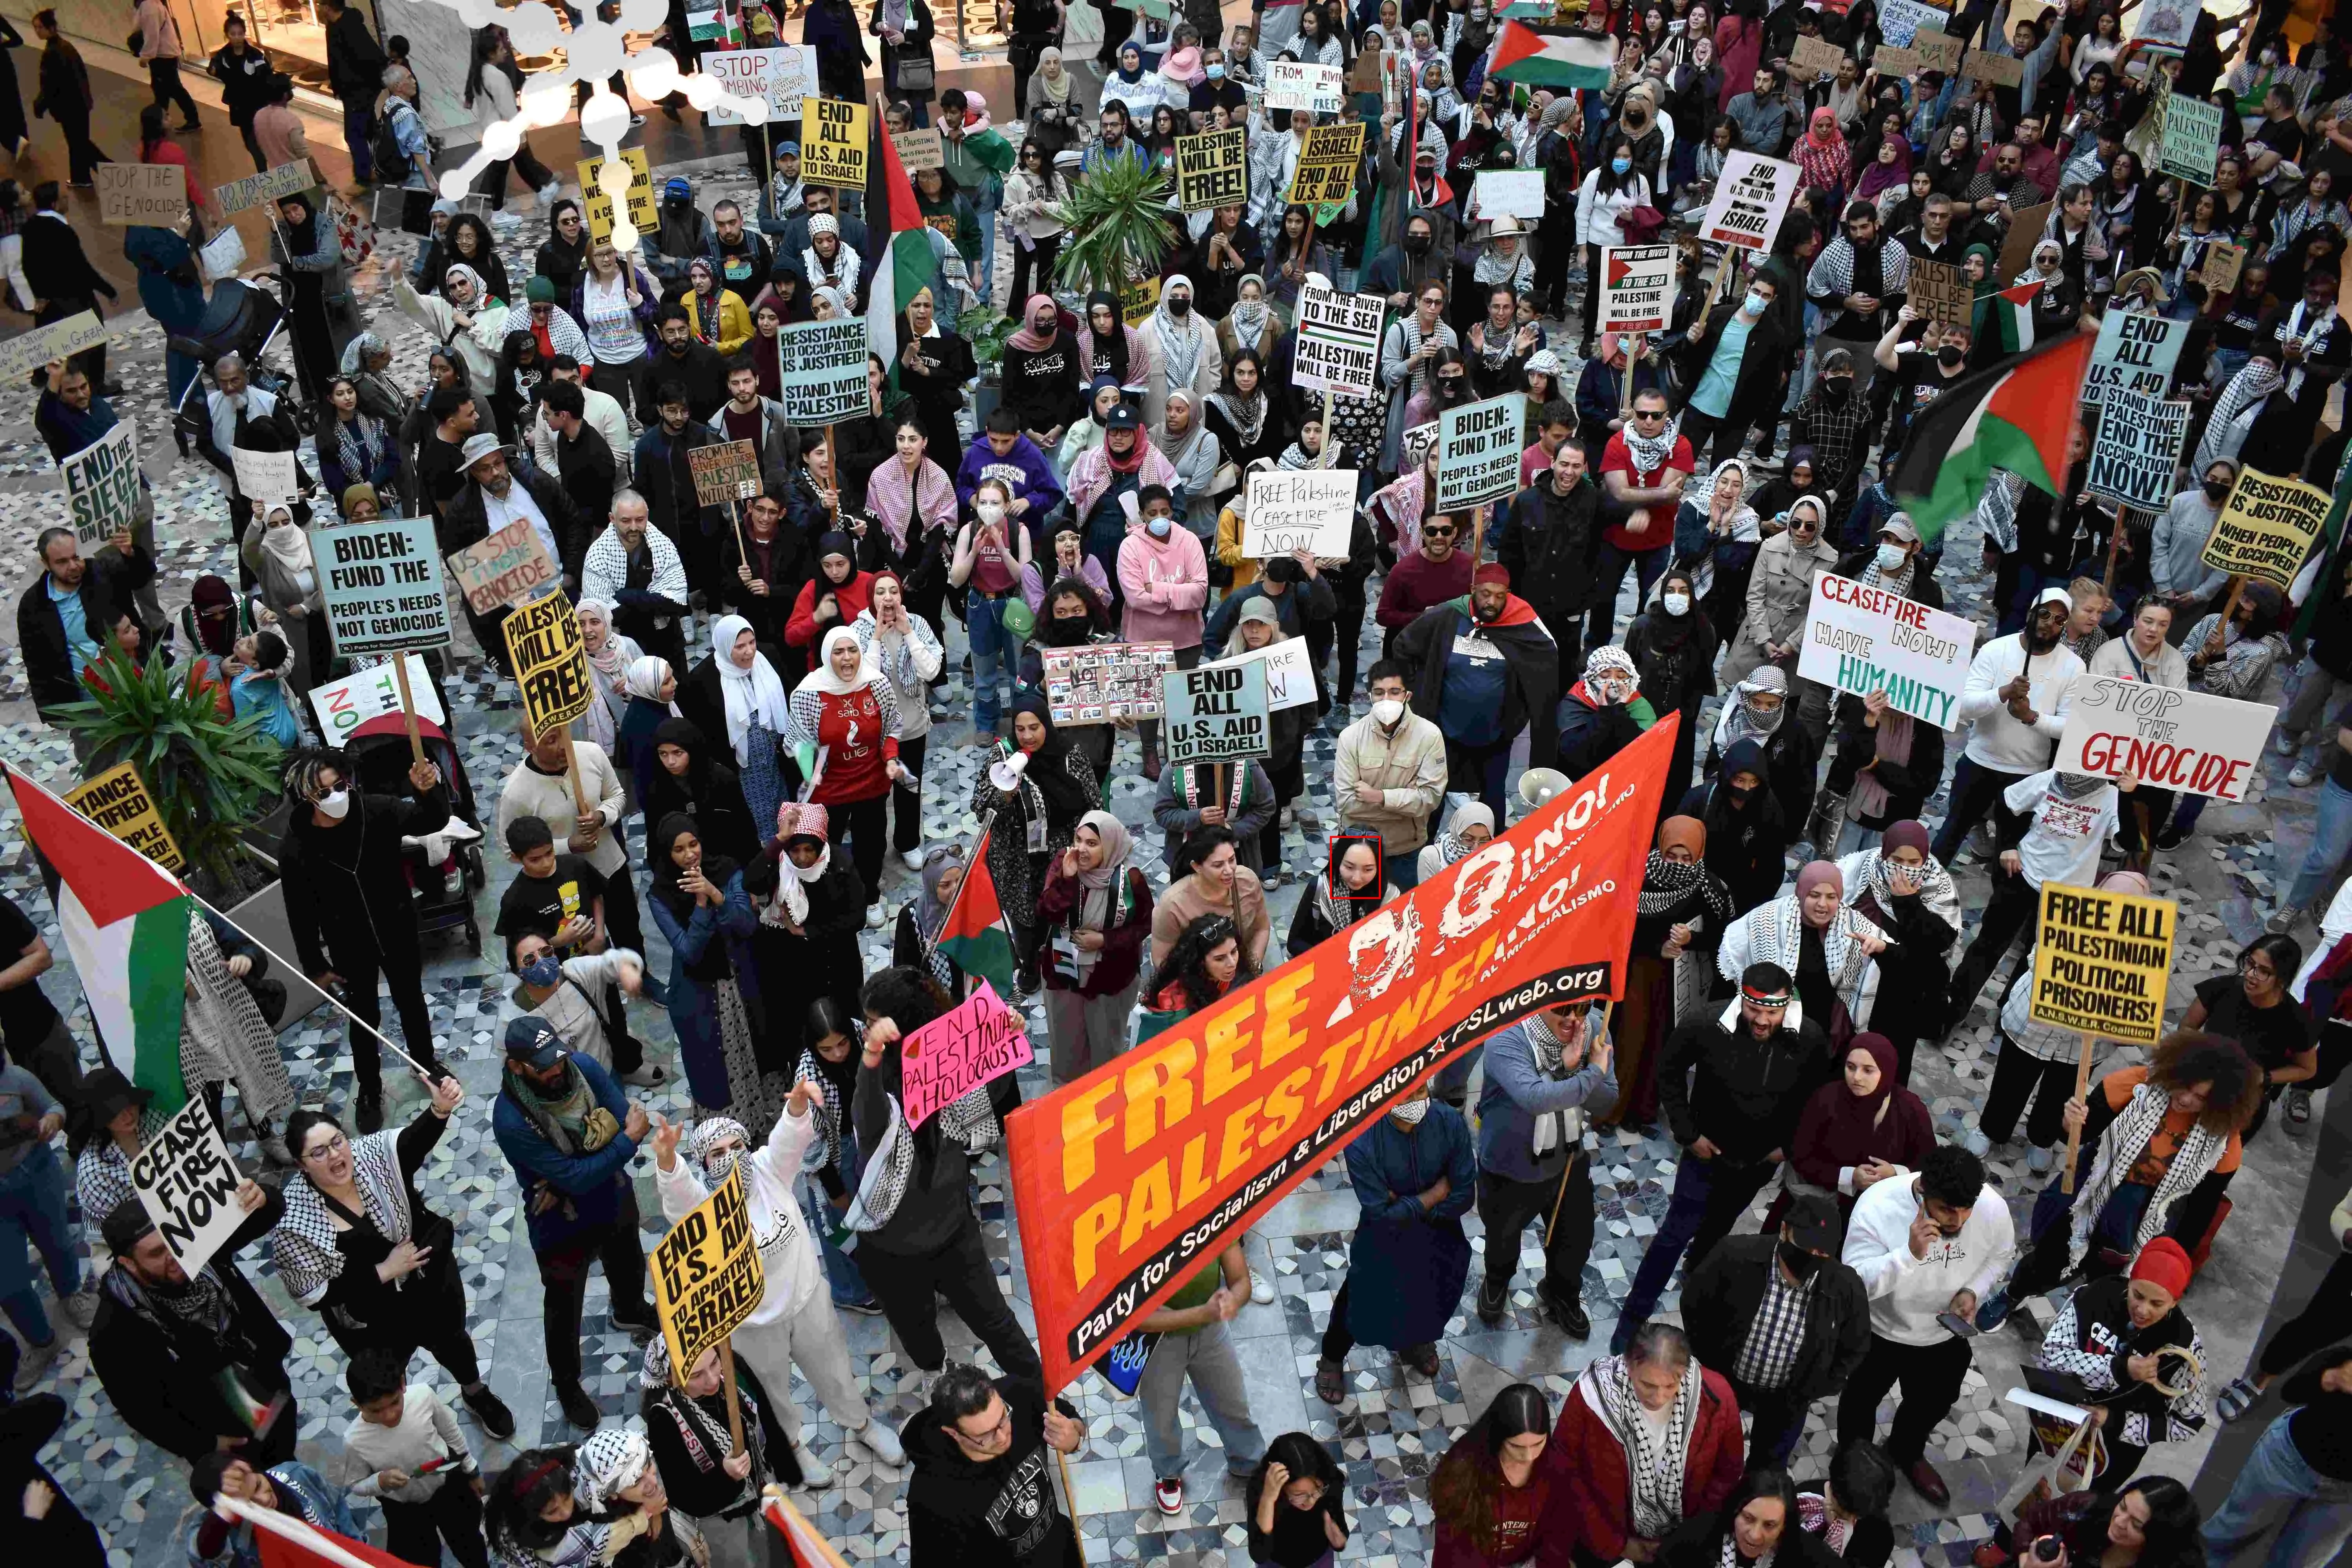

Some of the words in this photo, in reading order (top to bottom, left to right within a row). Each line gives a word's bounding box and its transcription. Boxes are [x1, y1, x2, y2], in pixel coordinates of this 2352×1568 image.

[2170, 96, 2195, 114] STAND
[2199, 105, 2220, 123] WITH
[1179, 131, 1242, 154] PALESTINE
[1310, 129, 1321, 139] TO
[1321, 125, 1361, 137] APARTHEID
[2167, 113, 2217, 144] PALESTINE
[1181, 151, 1219, 172] WILL
[1223, 147, 1242, 167] BE
[1307, 136, 1357, 156] ISRAEL!
[2163, 146, 2213, 171] OCCUPATION!
[2174, 137, 2189, 151] END
[2192, 142, 2207, 157] THE
[101, 167, 137, 190] STOP
[143, 167, 173, 187] THE
[1183, 168, 1242, 202] FREE!
[1297, 166, 1324, 184] END
[1327, 166, 1350, 183] ALL
[1749, 163, 1776, 179] END
[108, 192, 184, 216] GENOCIDE
[1294, 184, 1320, 201] U.S.
[1323, 182, 1346, 199] AID
[1730, 184, 1745, 197] U.S.
[1746, 187, 1763, 200] AID
[1764, 191, 1775, 201] TO
[1720, 210, 1769, 233] ISRAEL
[1612, 250, 1632, 260] FROM
[1633, 249, 1646, 259] THE
[1647, 247, 1668, 258] RIVER
[1621, 278, 1633, 287] TO
[1633, 276, 1648, 286] THE
[1650, 275, 1665, 285] SEA
[1305, 286, 1332, 303] FROM
[1335, 291, 1352, 305] THE
[1354, 294, 1381, 311] RIVER
[1611, 307, 1627, 318] WILL
[1629, 307, 1639, 317] BE
[1641, 306, 1660, 316] FREE
[1612, 291, 1661, 304] PALESTINE
[1304, 301, 1321, 319] TO
[1325, 305, 1350, 324] THE
[1352, 311, 1378, 331] SEA
[781, 323, 865, 345] RESISTANCE
[782, 345, 795, 358] TO
[799, 337, 865, 357] OCCUPATION
[783, 359, 795, 372] IS
[799, 349, 866, 371] JUSTIFIED!
[1297, 340, 1374, 369] PALESTINE
[1296, 358, 1322, 376] WILL
[1325, 365, 1342, 380] BE
[1345, 368, 1371, 386] FREE
[786, 381, 830, 400] STAND
[834, 376, 866, 393] WITH
[787, 390, 867, 415] PALESTINE
[2107, 388, 2149, 411] STAND
[2151, 400, 2186, 418] WITH
[2105, 404, 2183, 434] PALESTINE!
[2100, 423, 2138, 448] END
[2144, 432, 2180, 457] THE
[67, 443, 113, 495] END
[111, 433, 132, 466] THE
[2096, 441, 2175, 472] OCCUPATION
[980, 465, 1026, 483] ANDERSON
[2091, 462, 2169, 502] NOW!
[72, 454, 137, 527] SIEGE
[1254, 480, 1288, 506] FREE
[1290, 477, 1350, 503] Palestine
[2238, 475, 2328, 519] RESISTANCE
[2229, 494, 2245, 510] IS
[2246, 497, 2318, 536] JUSTIFIED
[80, 524, 96, 543] ON
[334, 532, 414, 562] BIDEN:
[1262, 532, 1314, 553] NOW
[2219, 522, 2258, 544] WHEN
[2259, 533, 2304, 560] PEOPLE
[2210, 537, 2233, 553] ARE
[2235, 543, 2296, 573] OCCUPIED!
[331, 565, 385, 589] FUND
[394, 560, 430, 584] THE
[2206, 556, 2251, 573] A.N.S.W.E.R.
[2253, 567, 2286, 584] Coalition
[400, 594, 442, 611] NEEDS
[1821, 576, 1931, 630] CEASEFIRE
[337, 619, 367, 637] NOT
[372, 612, 445, 634] GENOCIDE
[379, 640, 406, 648] Socialism
[419, 636, 447, 644] Liberation
[1815, 622, 1873, 658] HAVE
[1892, 623, 1957, 664] NOW!
[1187, 668, 1243, 695] END
[1837, 655, 1955, 726] HUMANITY
[1193, 692, 1241, 716] ALL
[2082, 680, 2182, 717] STOP
[1174, 722, 1216, 742] U.S.
[1223, 717, 1261, 737] AID
[2137, 718, 2178, 743] THE
[1172, 742, 1194, 757] TO
[1198, 735, 1263, 754] ISRAEL!
[2082, 732, 2251, 799] GENOCIDE
[1508, 884, 1526, 903] AL
[2046, 891, 2110, 931] FREE
[2118, 904, 2168, 941] ALL
[1479, 961, 1500, 984] AL
[1503, 880, 1615, 963] IMPERIALISMO
[2043, 929, 2166, 969] PALESTINIAN
[2051, 957, 2148, 998] POLITICAL
[2040, 982, 2156, 1024] PRISONERS!
[924, 997, 989, 1056] END
[2036, 1007, 2100, 1030] A.N.S.W.E.R.
[2103, 1022, 2152, 1038] Coalition
[903, 1009, 1011, 1096] PALESTINIA
[923, 1035, 1024, 1113] HOLOCAUST.
[1061, 962, 1317, 1194] FREE
[1071, 929, 1497, 1294] PALESTINE!
[133, 1107, 213, 1190] CEASE
[1075, 1288, 1134, 1356] Party
[1142, 1258, 1176, 1293] for
[1180, 1158, 1288, 1258] Socialism
[1293, 1139, 1310, 1162] &
[1314, 1053, 1426, 1146] Liberation
[1450, 967, 1603, 1043] PSLweb.org
[156, 1138, 222, 1213] FIRE
[160, 1159, 236, 1257] NOW
[657, 1211, 708, 1281] END
[666, 1249, 718, 1306] U.S.
[671, 1303, 687, 1329] TO
